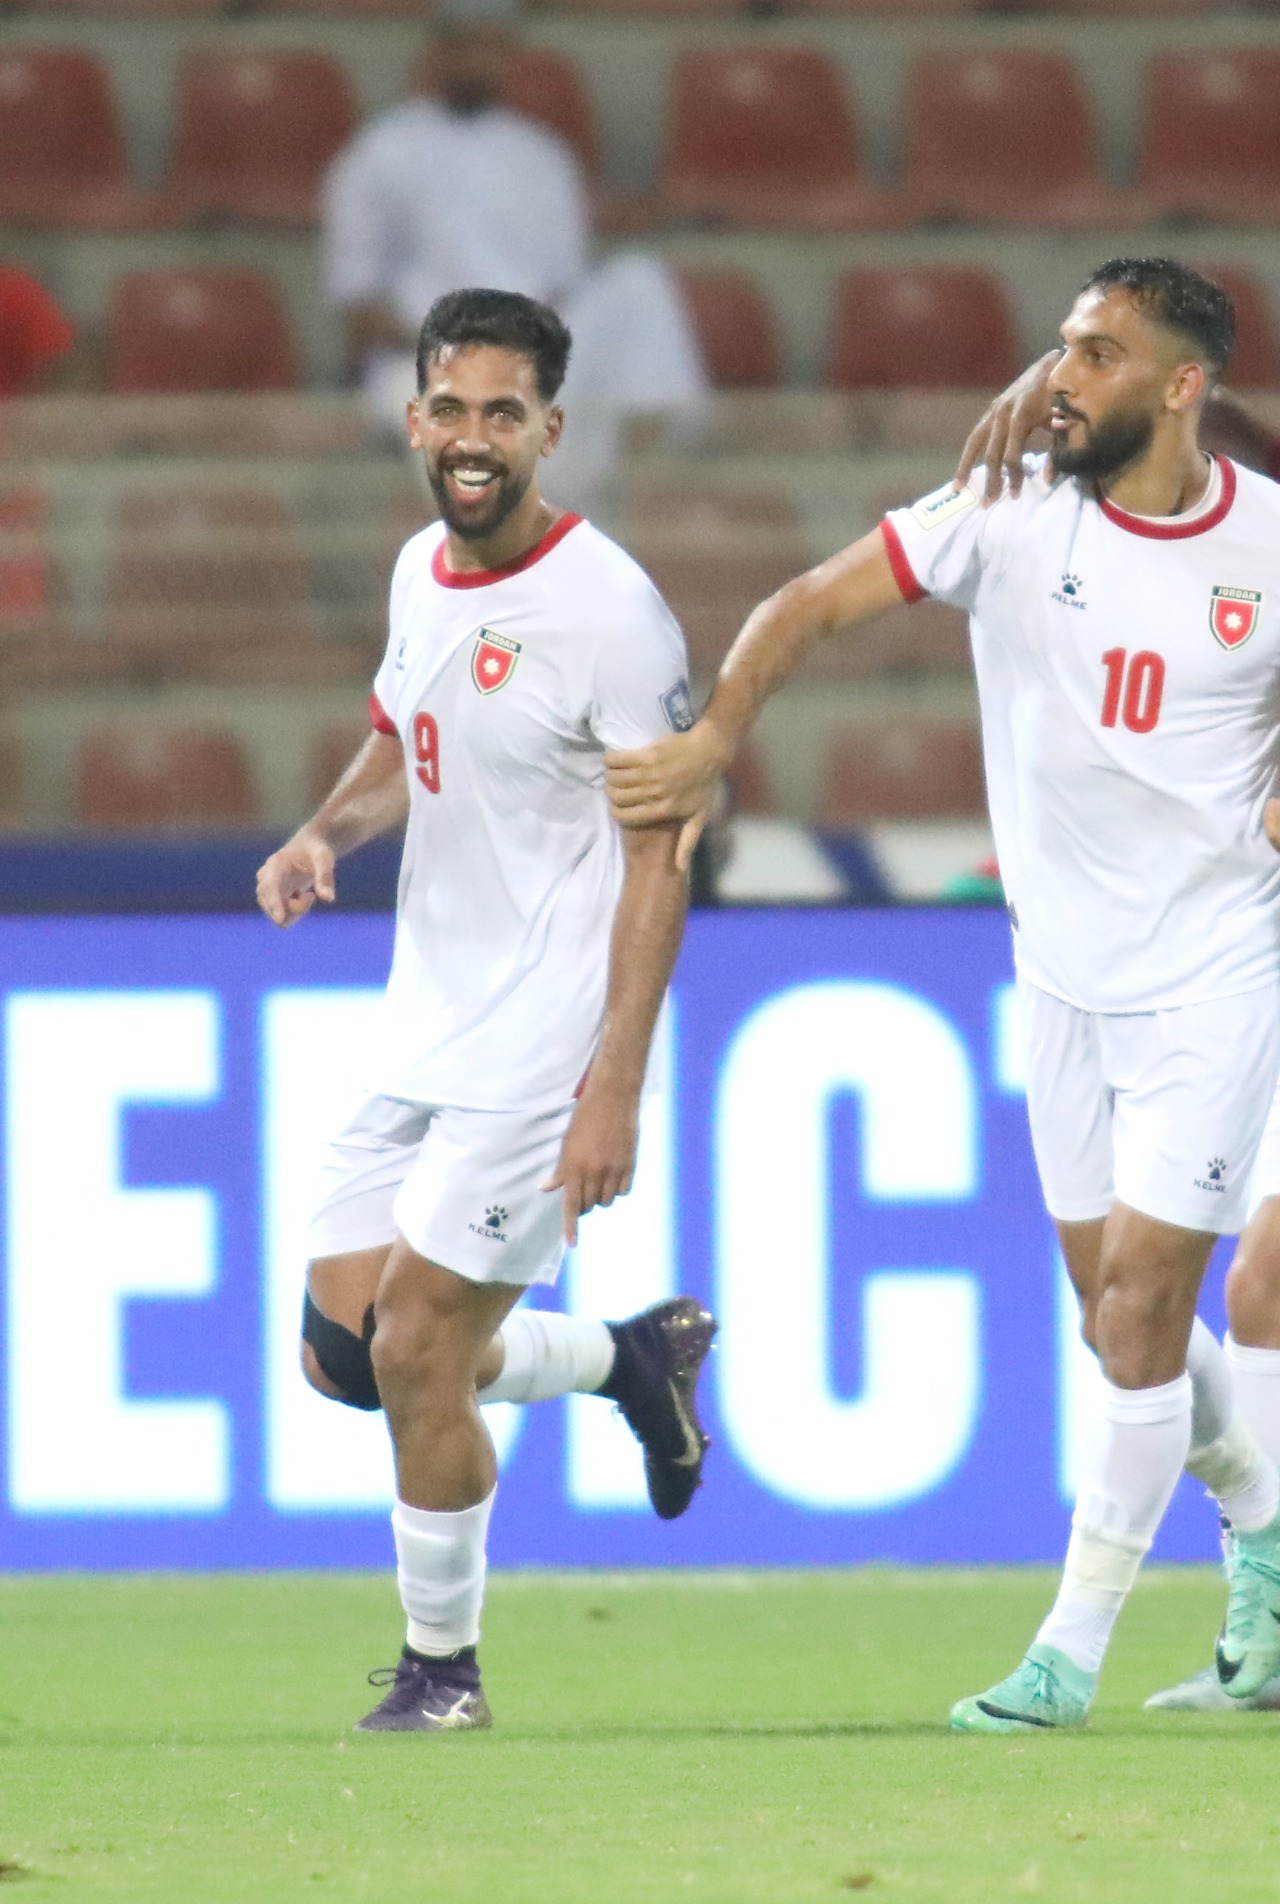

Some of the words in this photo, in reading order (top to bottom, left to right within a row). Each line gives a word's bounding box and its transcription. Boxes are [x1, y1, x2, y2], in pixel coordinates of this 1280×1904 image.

[1218, 587, 1256, 602] JORDAN
[484, 630, 518, 651] JORDAN
[1101, 647, 1165, 734] 10
[414, 711, 441, 794] 9
[468, 1222, 508, 1243] KELME
